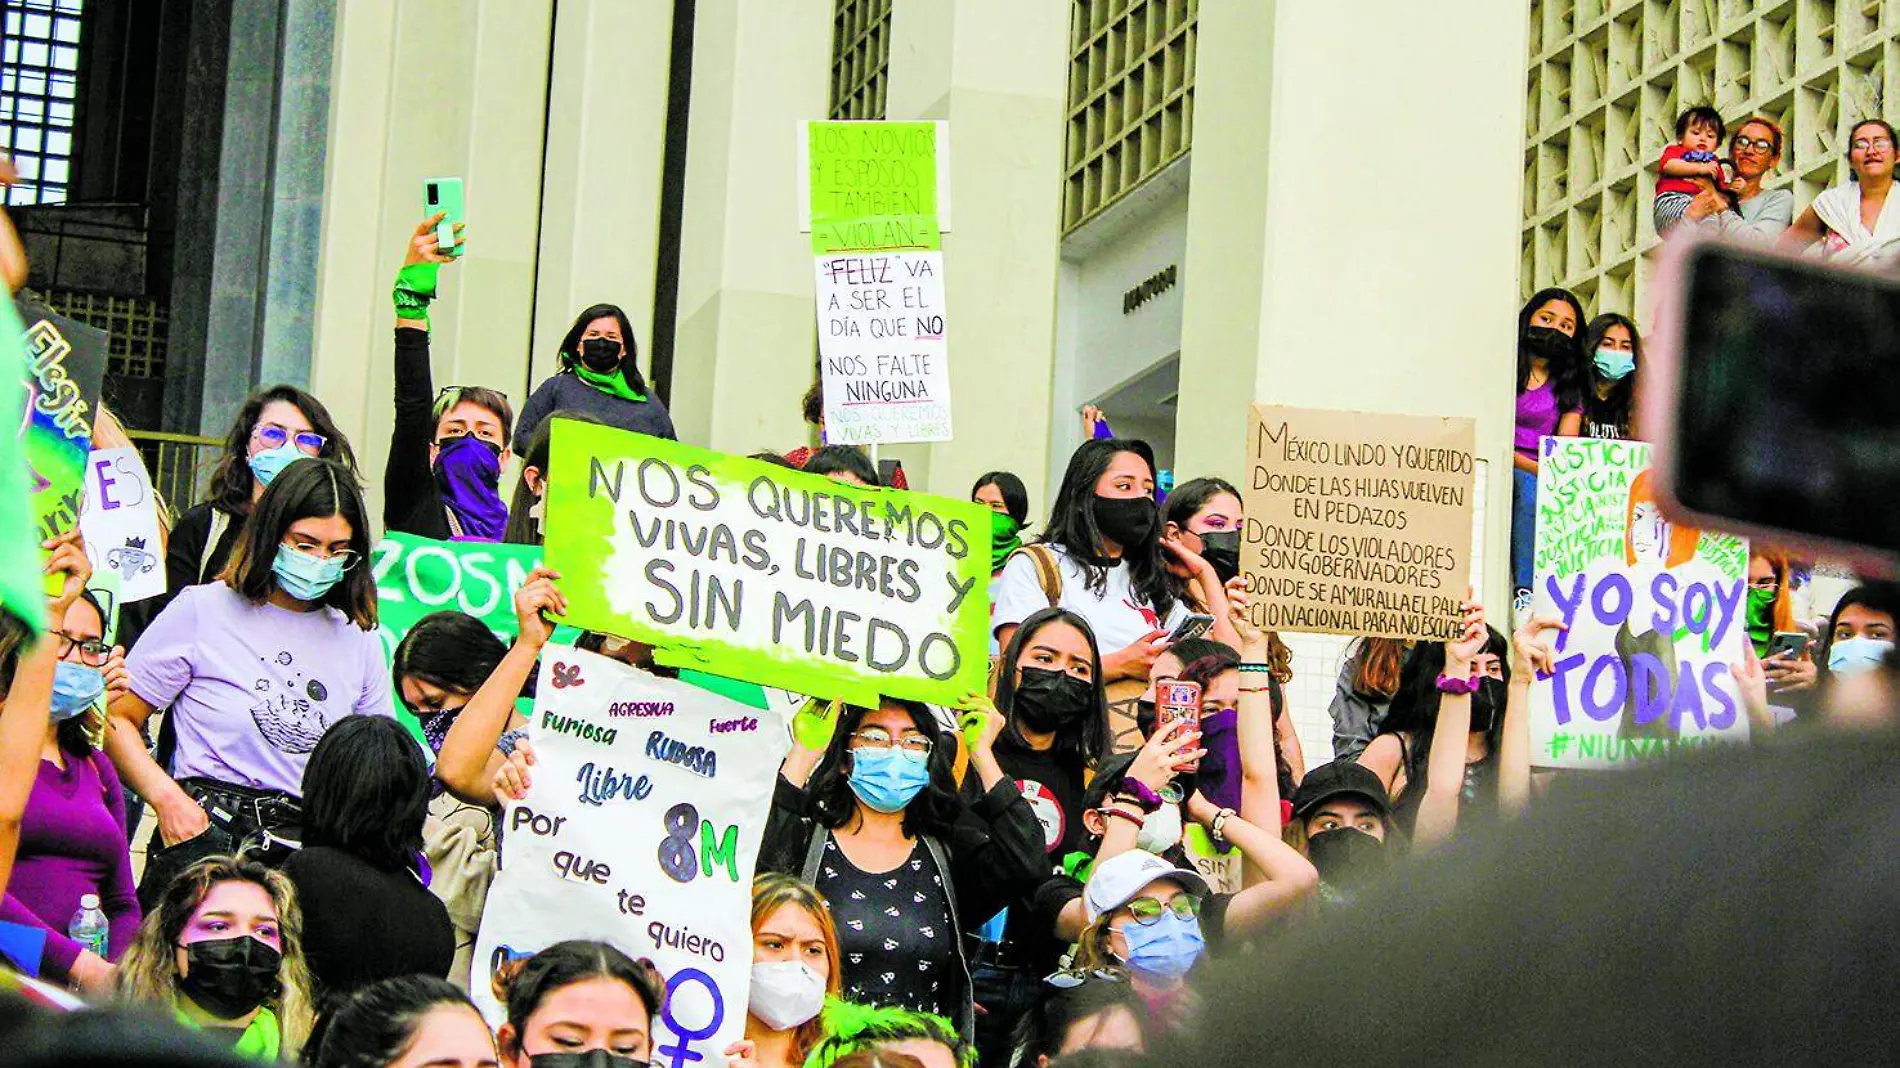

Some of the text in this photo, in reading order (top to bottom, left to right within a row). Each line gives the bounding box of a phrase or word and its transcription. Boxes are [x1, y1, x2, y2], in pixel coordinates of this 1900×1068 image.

[834, 159, 919, 188] ESPOSOS
[832, 221, 915, 247] VIOLAN
[905, 260, 933, 278] VA
[828, 286, 930, 311] A SER EL
[830, 315, 944, 339] DÍA QUE NO
[829, 354, 931, 377] NOS FALTE
[846, 380, 929, 401] NINGUNA
[1334, 444, 1386, 467] LINDO
[1253, 465, 1464, 507] DONDE LAS HIJAS VUELVEN
[589, 456, 970, 559] NOS QUEREMOS
[1294, 498, 1408, 530] EN PEDAZOS
[630, 510, 976, 614] VIVAS, LIBRES Y
[1246, 518, 1456, 571] DONDE LOS VIOLADORES
[1260, 548, 1441, 589] SON GOBERNADORES
[1245, 571, 1305, 599] DONDE
[1309, 582, 1327, 602] SE
[1331, 584, 1410, 613] AMURALLA
[1411, 595, 1428, 616] EL
[644, 558, 961, 681] SIN MIEDO
[1281, 603, 1361, 631] NACIONAL
[1363, 611, 1398, 634] PARA
[1400, 614, 1419, 635] NO
[1546, 572, 1745, 653] YO SOY
[1535, 652, 1737, 731] TODAS
[708, 716, 758, 734] Fuerte
[645, 730, 718, 778] RUDOSA
[576, 762, 652, 807] Libre
[658, 802, 739, 883] 8M
[553, 851, 611, 884] que
[617, 888, 646, 915] te
[648, 920, 725, 963] quiero
